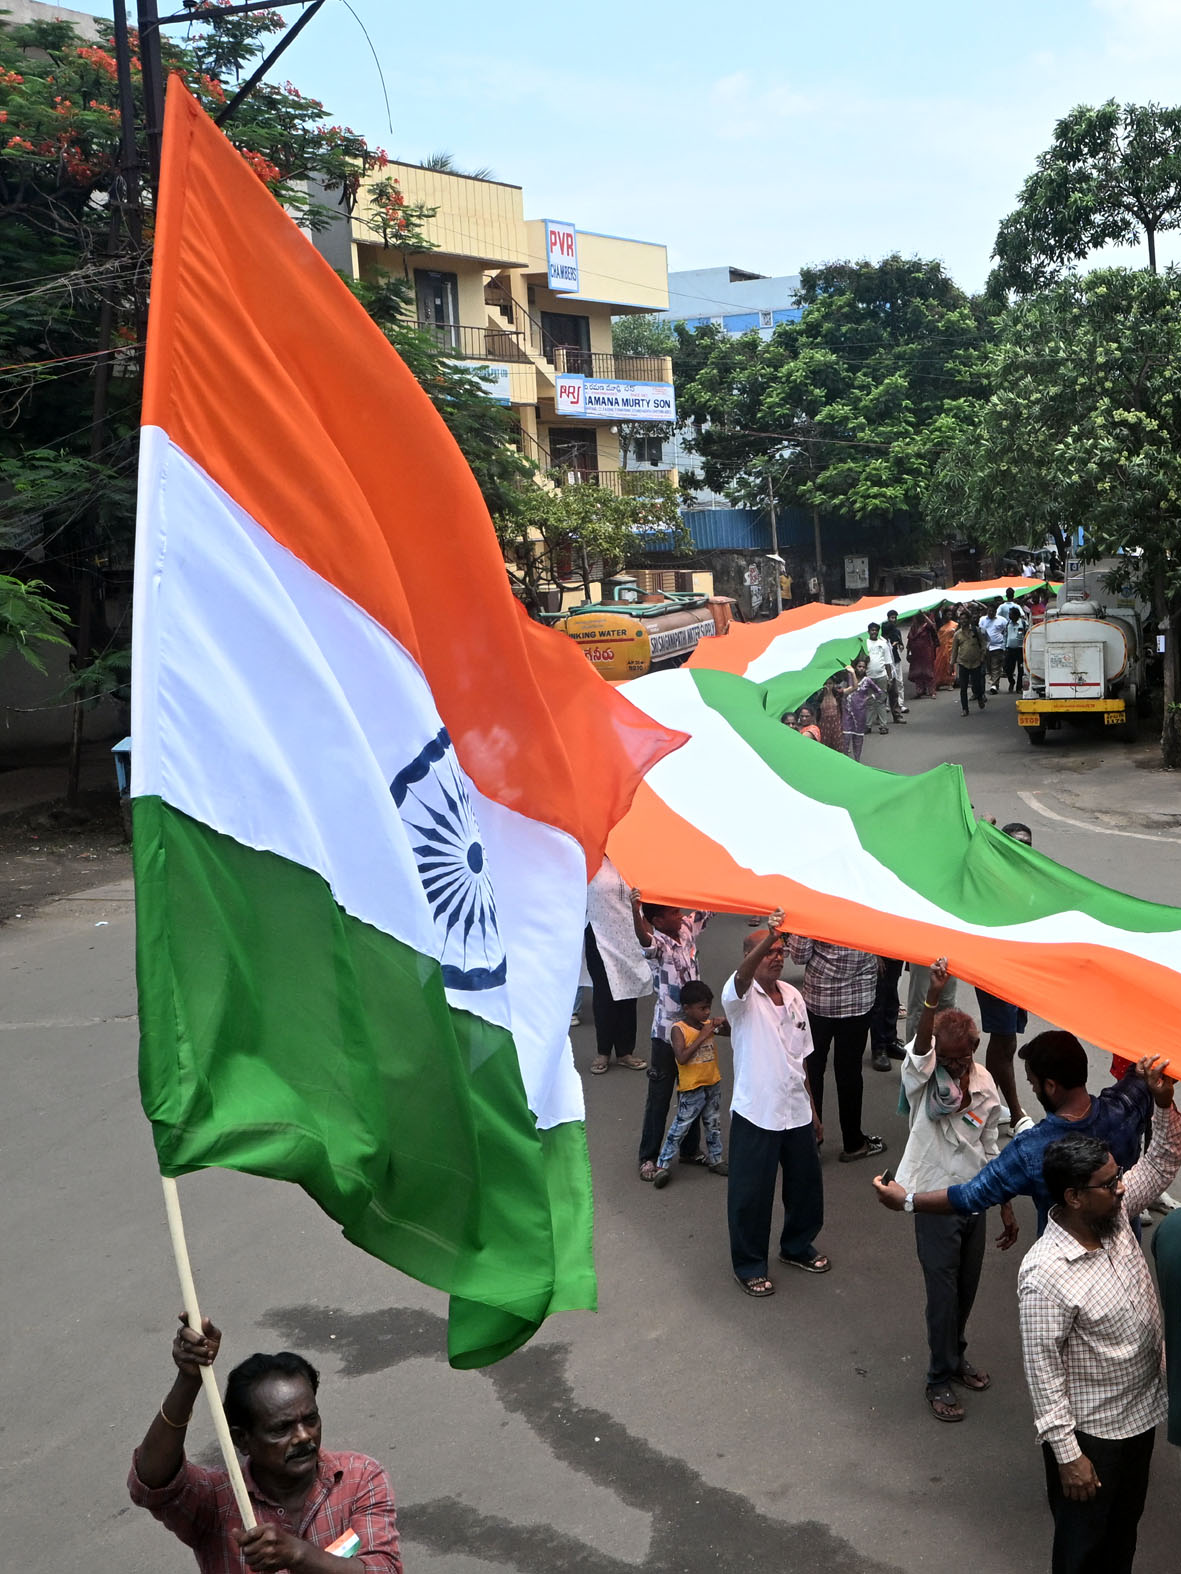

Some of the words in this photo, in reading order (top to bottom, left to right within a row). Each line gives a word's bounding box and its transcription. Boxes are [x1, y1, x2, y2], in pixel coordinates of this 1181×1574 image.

[549, 229, 574, 257] PVR
[550, 263, 577, 281] CHAMBERS
[621, 397, 651, 408] MURTY
[653, 399, 671, 409] SON
[598, 629, 627, 637] WATER
[1019, 717, 1040, 725] STOP
